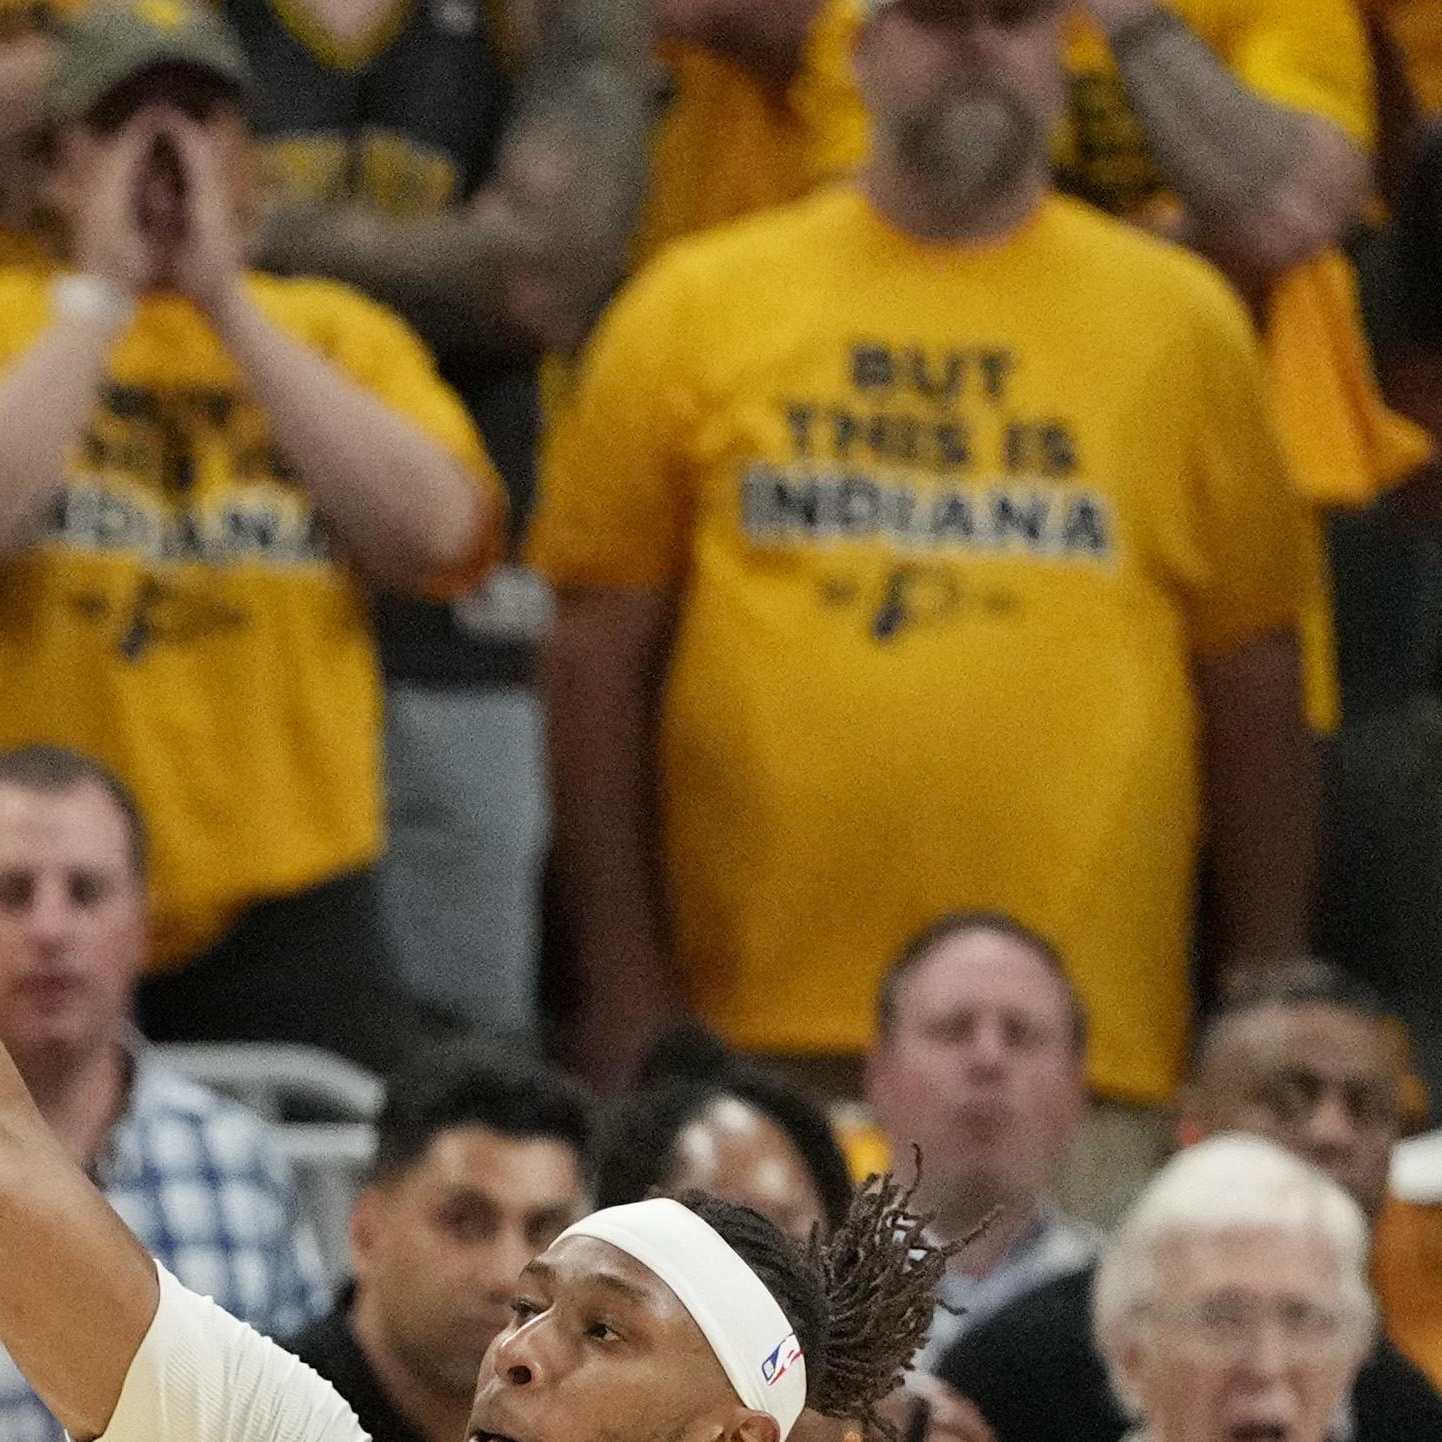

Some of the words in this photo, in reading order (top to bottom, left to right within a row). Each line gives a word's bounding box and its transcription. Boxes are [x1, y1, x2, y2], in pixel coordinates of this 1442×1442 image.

[851, 343, 1013, 400] BUT
[785, 402, 971, 470] THIS
[742, 470, 1109, 560] INDIANA
